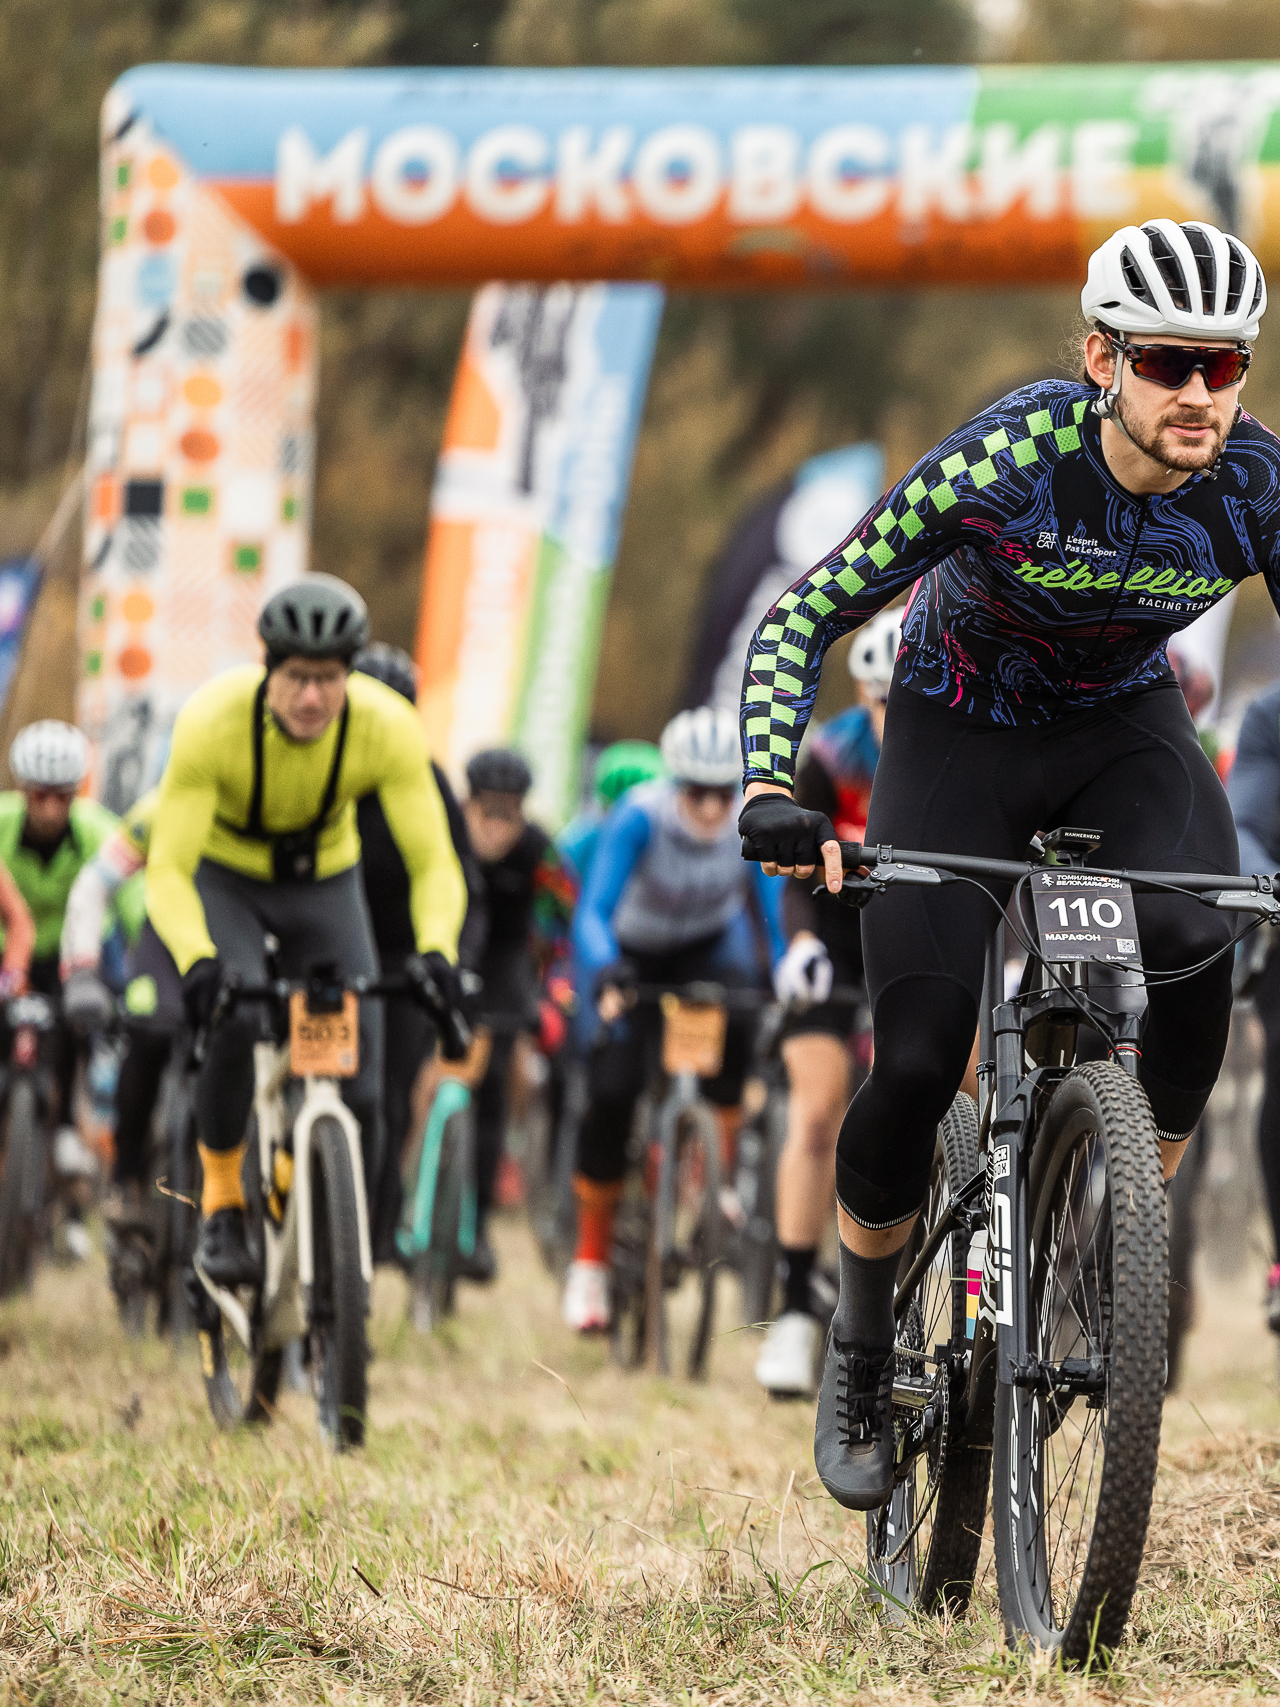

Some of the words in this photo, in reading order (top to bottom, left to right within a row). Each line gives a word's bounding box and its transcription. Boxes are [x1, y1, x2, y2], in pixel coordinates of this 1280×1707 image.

[274, 120, 1138, 226] МОСКОВСКИЕ
[1039, 531, 1057, 540] FAT
[1066, 535, 1098, 547] L'esprit
[1036, 539, 1056, 549] CAT
[1065, 543, 1080, 553] Pas
[1081, 546, 1092, 554] Le
[1092, 547, 1117, 557] Sport
[1138, 597, 1182, 611] RACING
[1186, 600, 1212, 611] TEAM
[1064, 831, 1100, 840] HAMMERHEAD
[1048, 897, 1123, 928] 110
[1045, 933, 1101, 942] МАРАФОН
